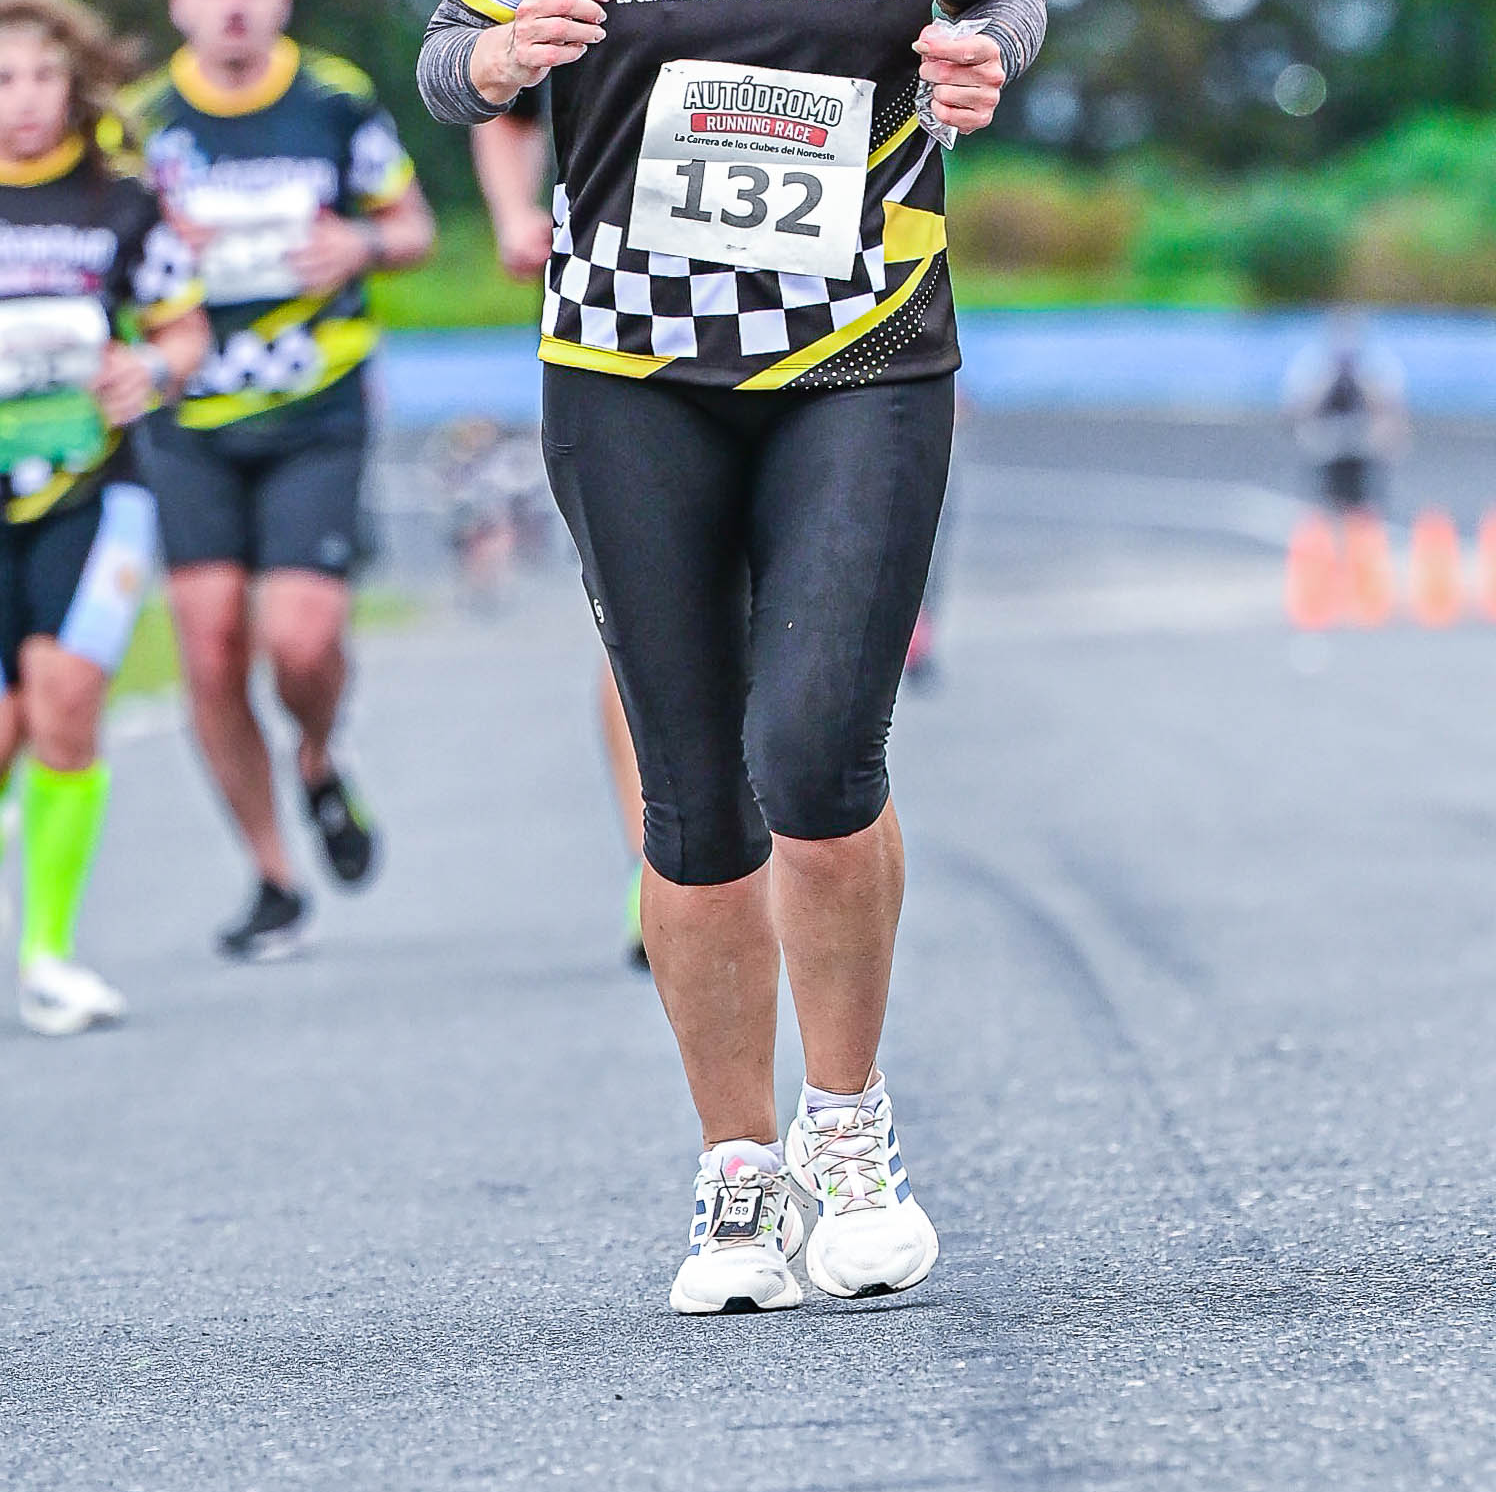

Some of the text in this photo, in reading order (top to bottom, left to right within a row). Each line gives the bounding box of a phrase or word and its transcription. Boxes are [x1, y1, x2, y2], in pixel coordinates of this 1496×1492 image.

[683, 75, 843, 127] AUTÓDROMO
[674, 133, 835, 161] La Carrera de los Clubes del Noroeste
[706, 115, 813, 143] RUNNING RACE
[670, 158, 823, 238] 132
